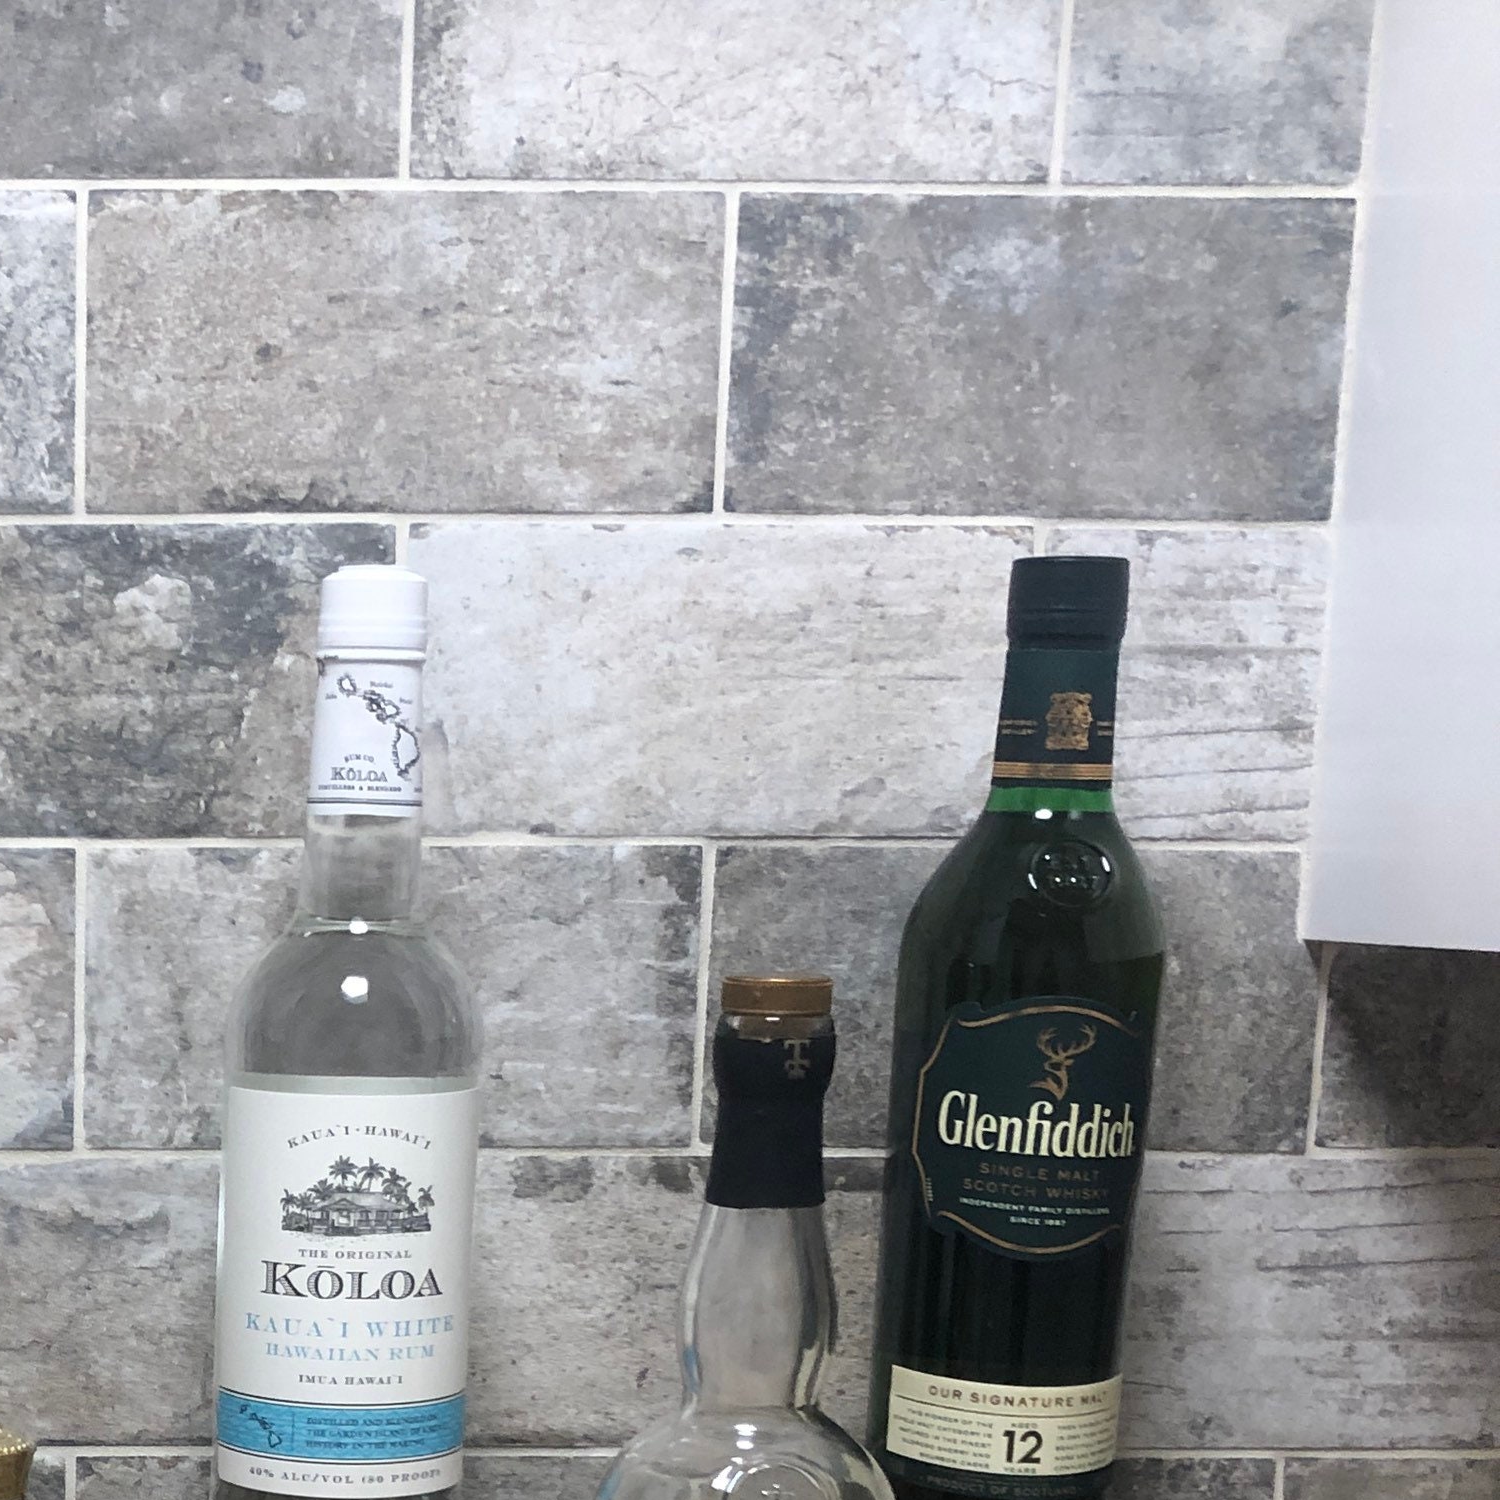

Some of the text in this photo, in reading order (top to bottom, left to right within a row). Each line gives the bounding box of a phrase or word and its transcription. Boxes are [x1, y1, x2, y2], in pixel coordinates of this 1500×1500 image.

[938, 1090, 1135, 1158] Glenfiddich
[979, 1162, 1100, 1182] SINGLE MALT
[962, 1178, 1037, 1198] SCOTCH
[958, 1196, 1025, 1212] INDEPENDENT
[1028, 1205, 1063, 1215] FAMILY
[1010, 1216, 1040, 1226] SINCE
[298, 1248, 412, 1260] THE ORIGINAL
[366, 1314, 455, 1338] WHITE
[266, 1342, 436, 1362] HAWAIIAN RUM
[299, 1374, 338, 1386] IMUA
[928, 1384, 964, 1401] OUR
[970, 1391, 1074, 1409] SIGNATURE
[1002, 1430, 1044, 1464] 12
[249, 1466, 275, 1478] 40%
[280, 1472, 354, 1484] ALC/VOL
